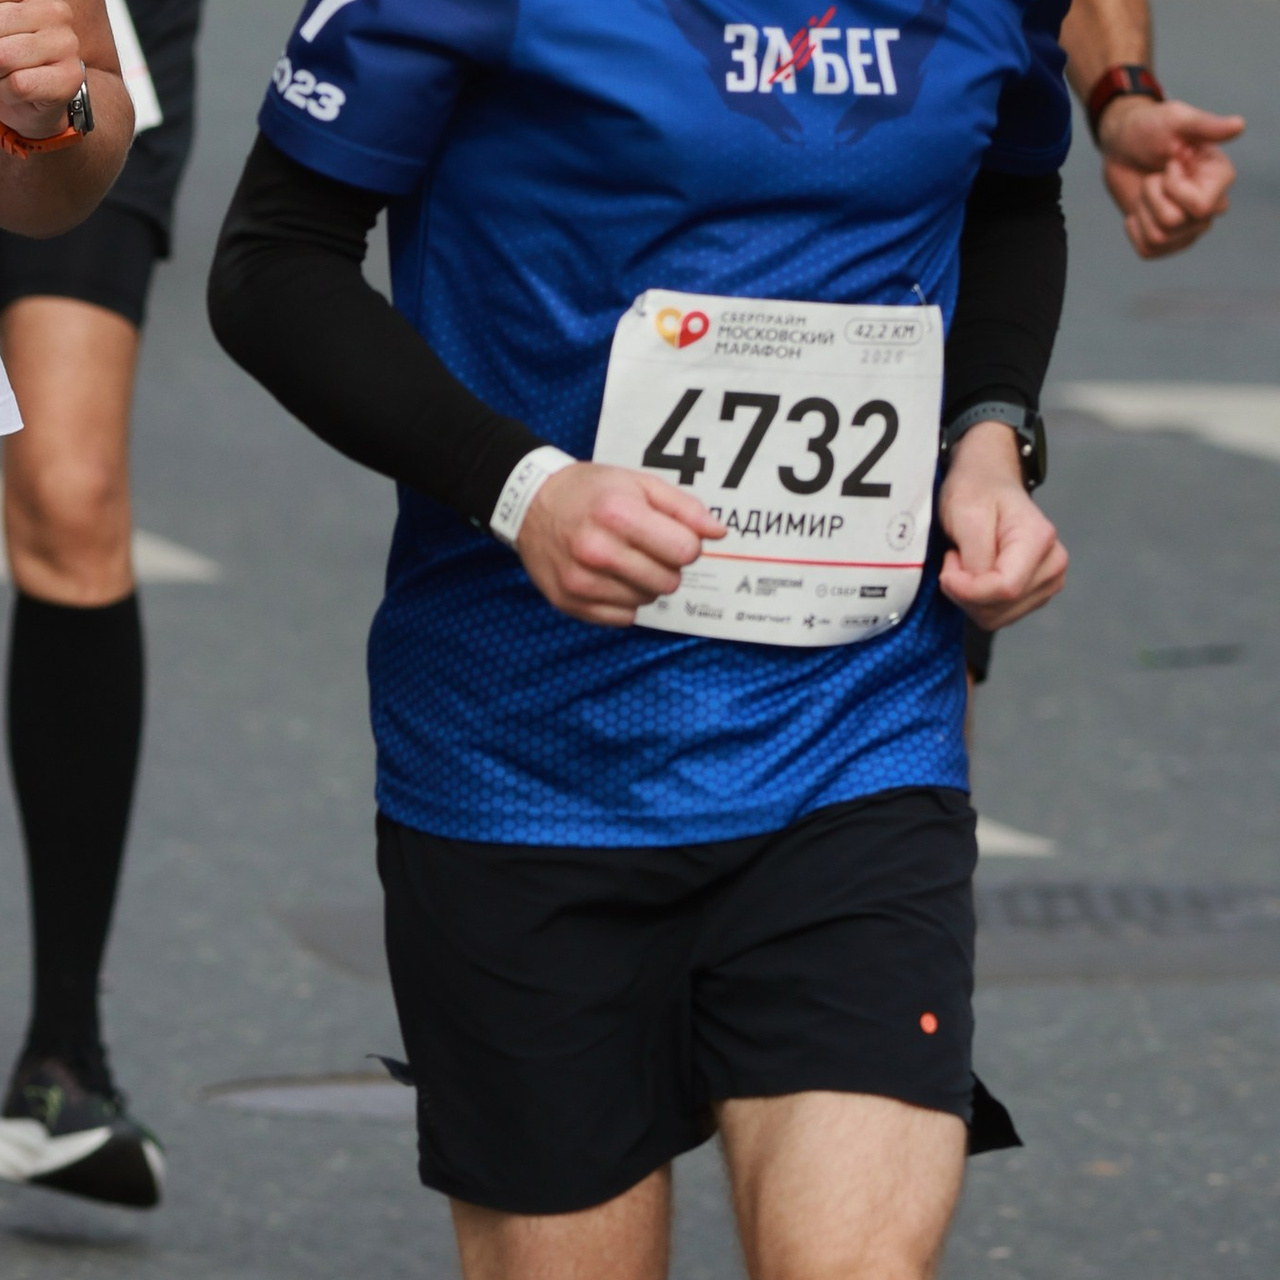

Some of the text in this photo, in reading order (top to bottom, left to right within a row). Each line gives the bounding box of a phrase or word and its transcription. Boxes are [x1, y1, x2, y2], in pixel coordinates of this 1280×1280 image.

[272, 50, 347, 122] 023
[714, 341, 803, 361] МАРАФОН
[717, 325, 835, 346] МОСКОВСКИЙ
[641, 388, 901, 499] 4732
